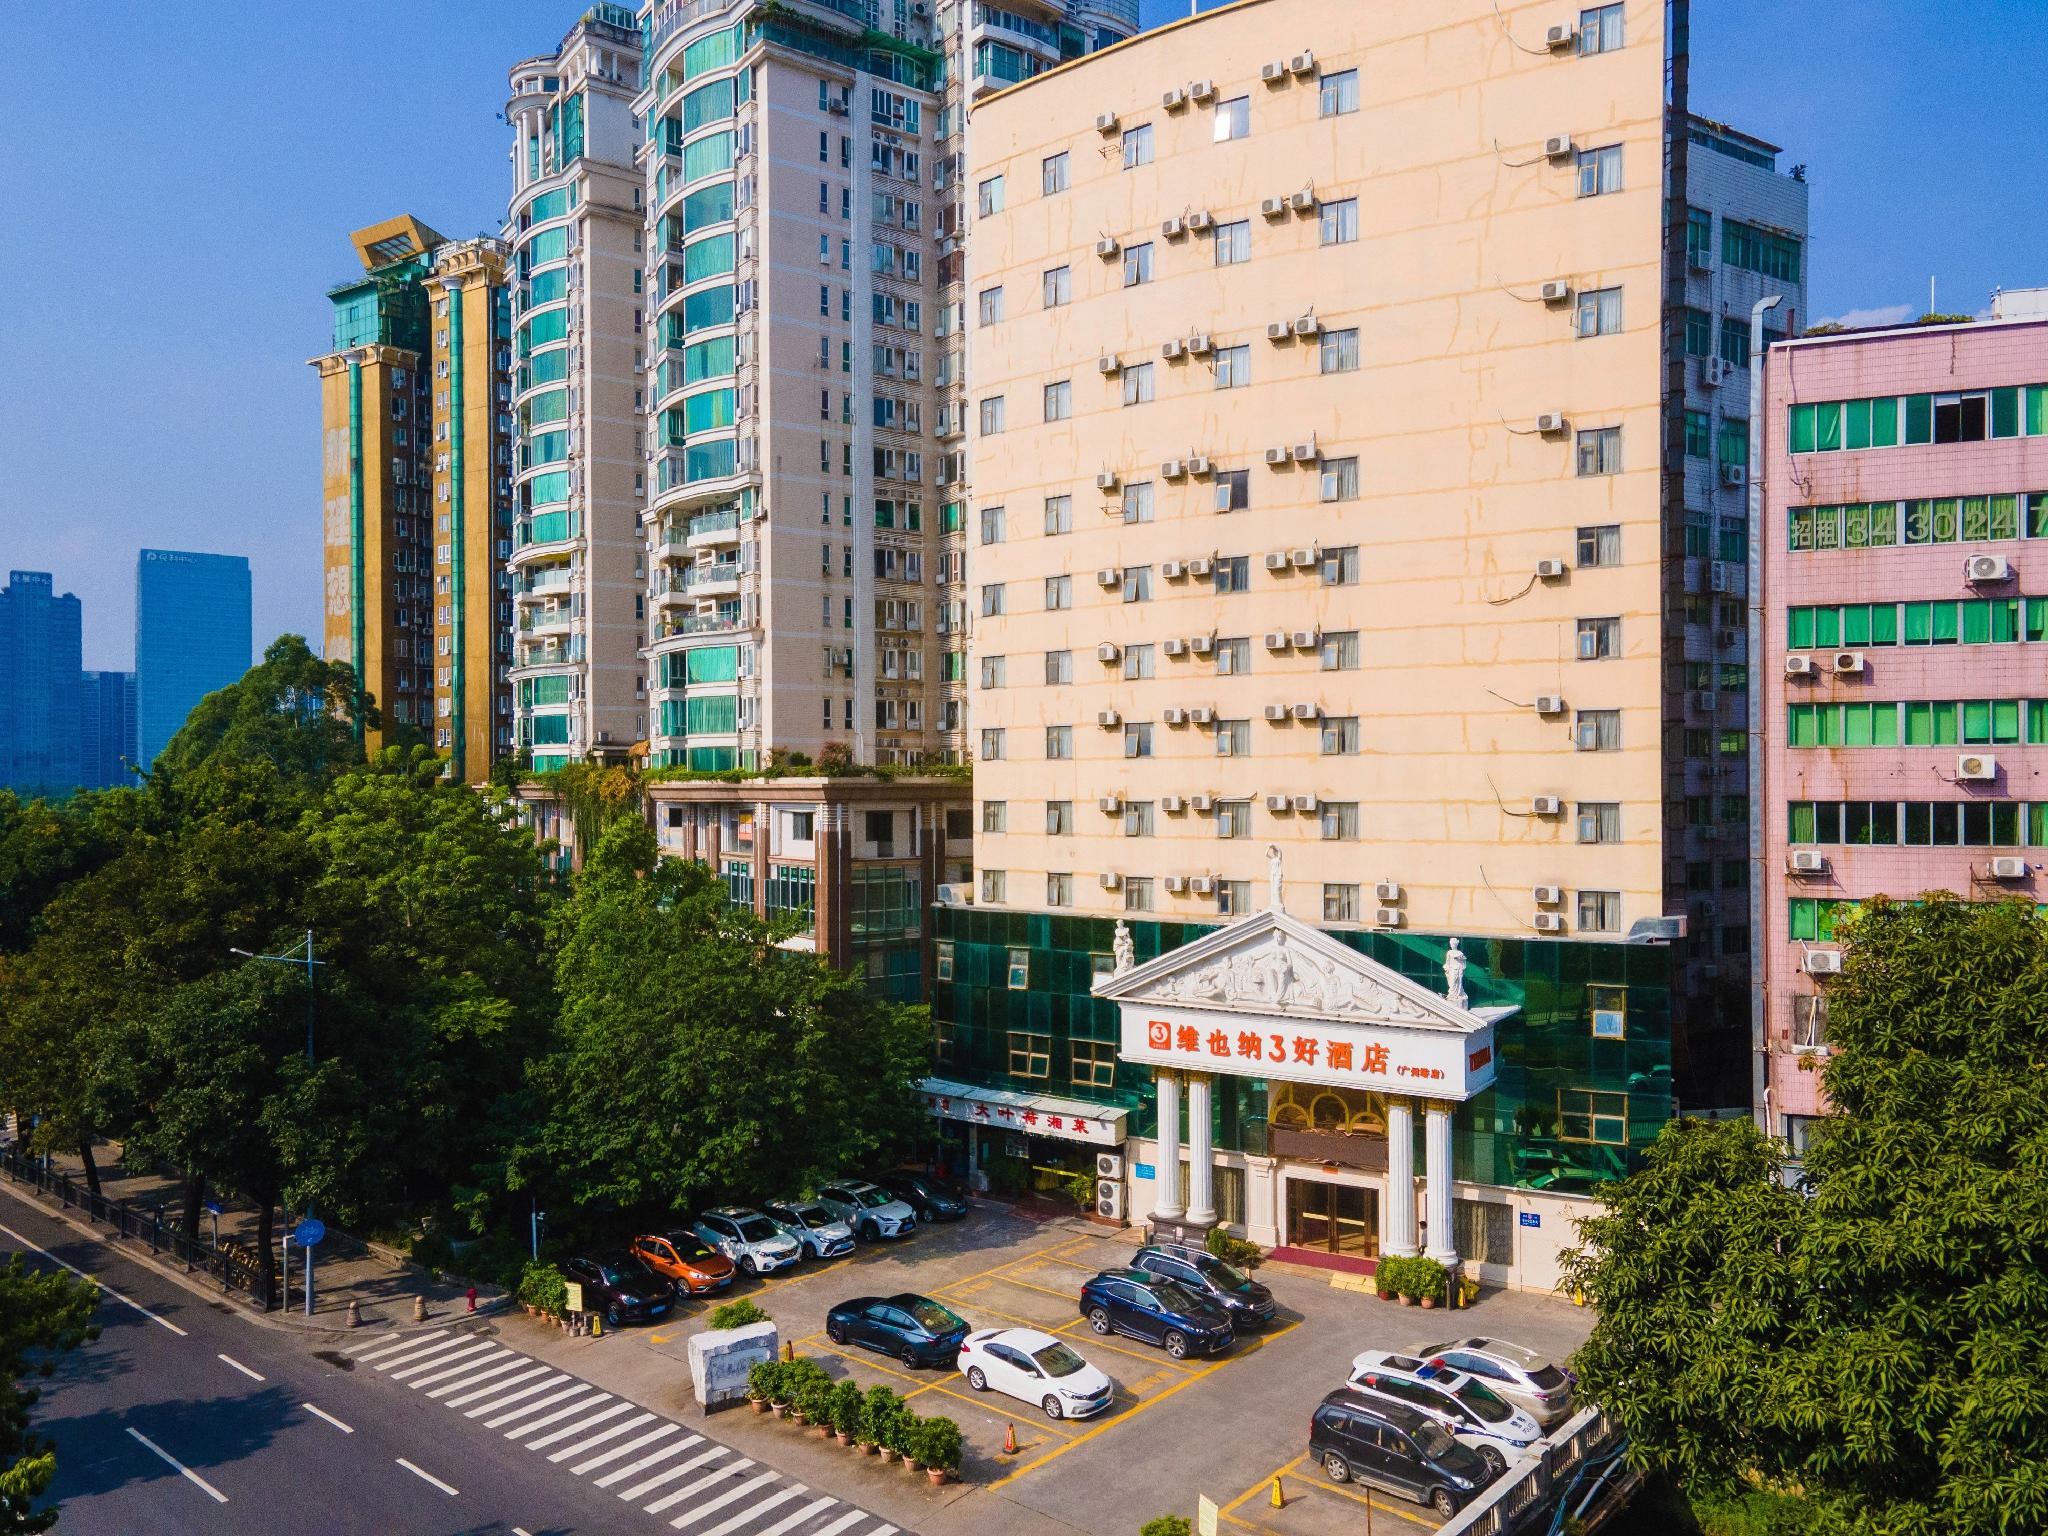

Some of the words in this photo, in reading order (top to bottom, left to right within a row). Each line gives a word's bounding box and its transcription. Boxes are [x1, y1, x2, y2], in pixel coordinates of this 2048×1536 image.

[1792, 519, 1838, 547] 招租
[1176, 1024, 1391, 1075] 维也纳3好酒店
